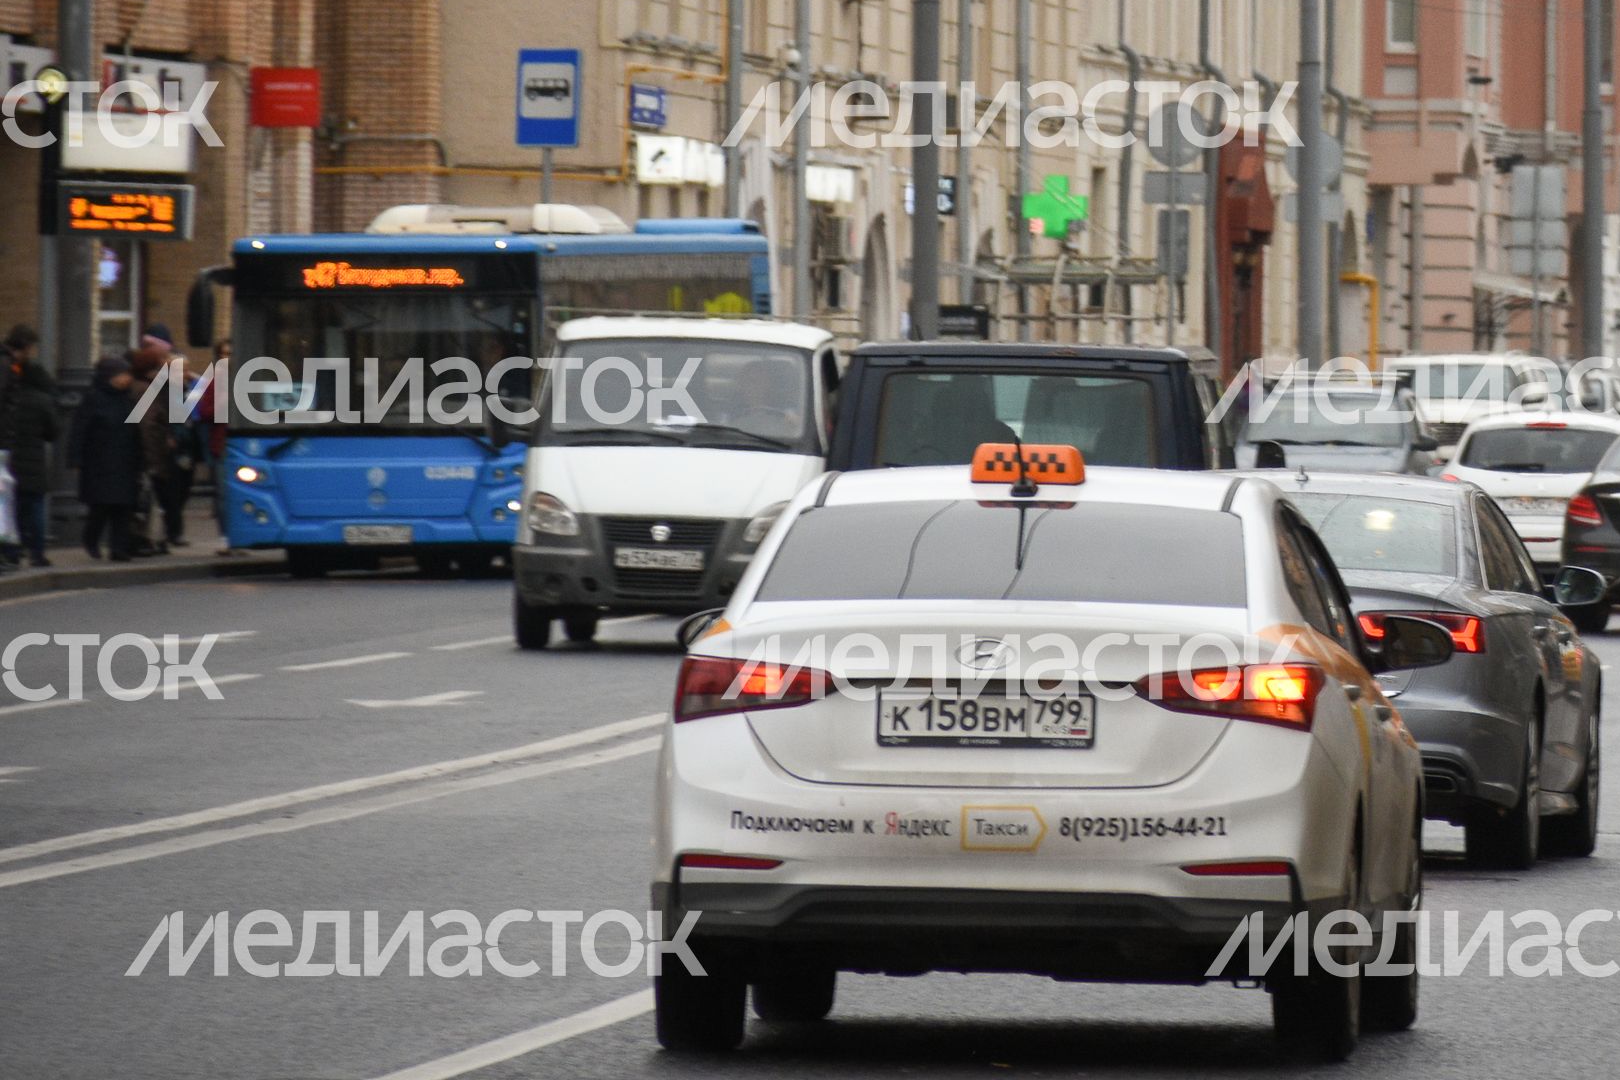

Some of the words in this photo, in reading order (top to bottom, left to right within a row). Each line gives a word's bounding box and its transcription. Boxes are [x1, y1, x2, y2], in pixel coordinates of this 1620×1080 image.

[1033, 699, 1084, 725] 799
[730, 810, 855, 834] Подключаем
[863, 819, 876, 834] к
[883, 811, 952, 839] Яндекс
[973, 818, 1029, 836] Такси
[1058, 816, 1227, 843] 8(925)156-44-21
